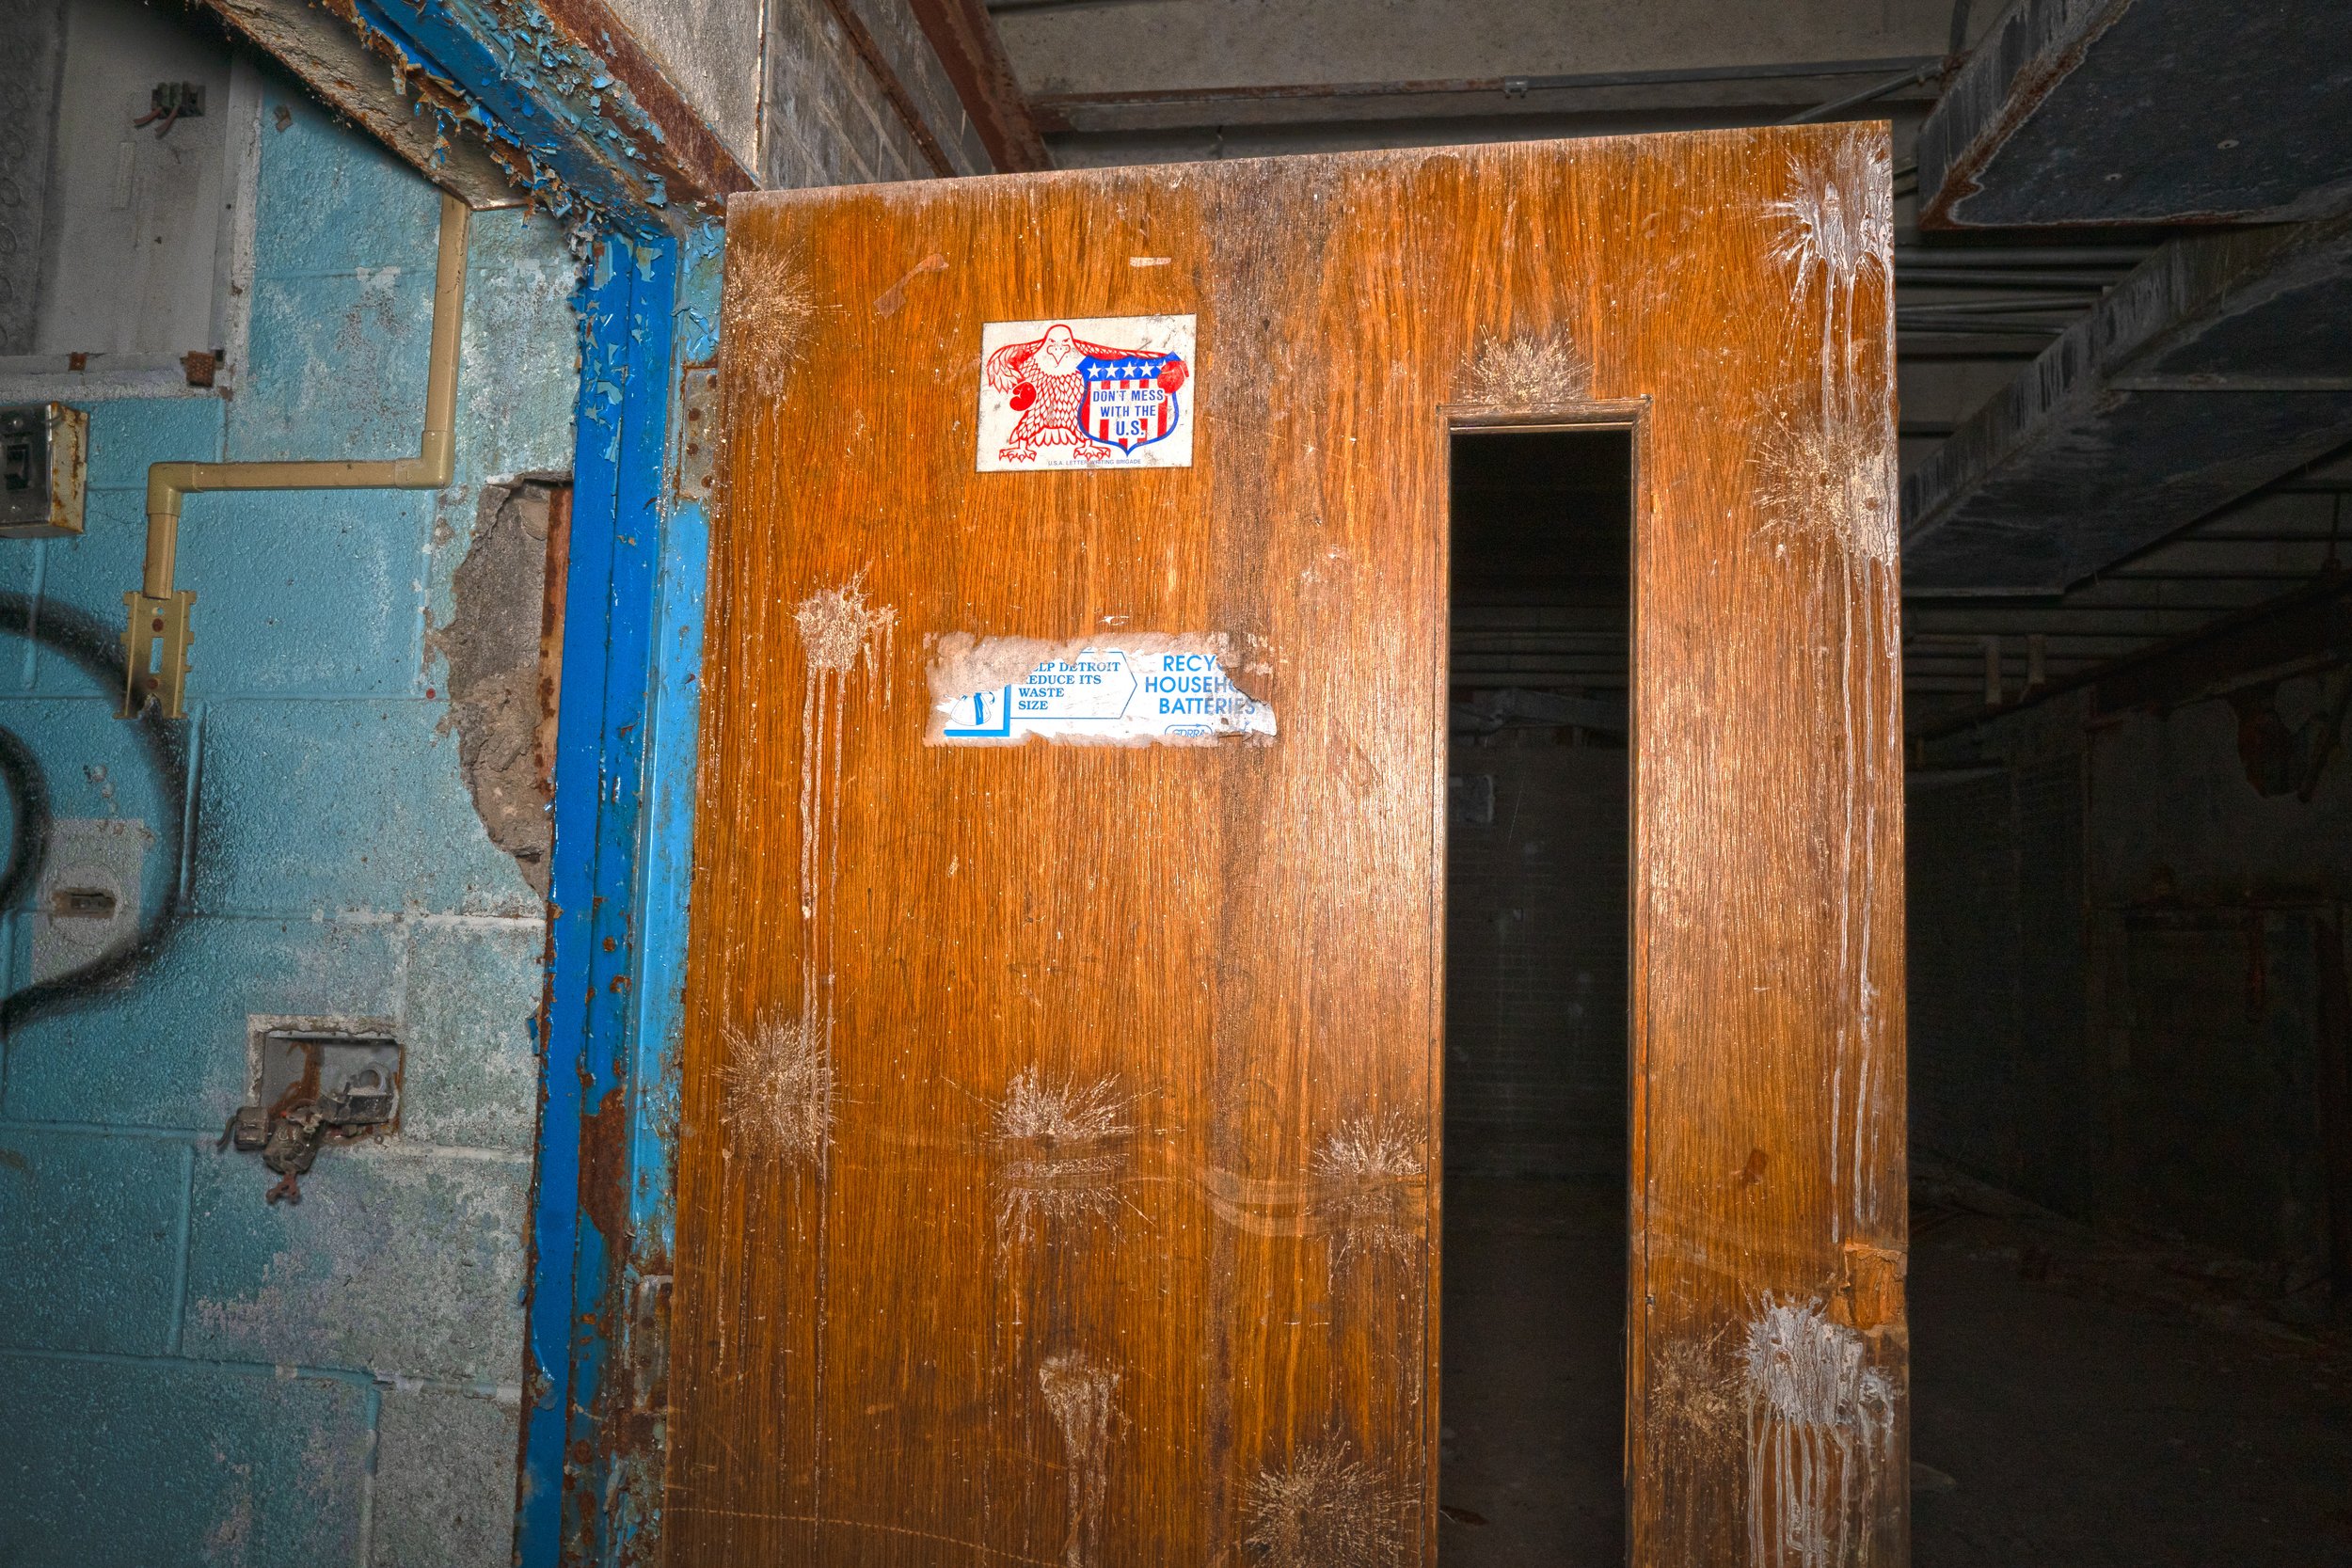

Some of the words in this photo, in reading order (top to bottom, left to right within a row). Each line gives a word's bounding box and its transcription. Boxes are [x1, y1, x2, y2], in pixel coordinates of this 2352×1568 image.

[1093, 390, 1127, 402] DON'T
[1131, 389, 1164, 401] MESS
[1100, 405, 1130, 417] WITH
[1135, 404, 1156, 416] THE
[1116, 420, 1145, 436] U.S.
[1058, 661, 1121, 673] DETROIT
[1163, 654, 1223, 672] RECY
[1025, 674, 1075, 685] EDUCE
[1079, 674, 1102, 685] ITS
[1018, 688, 1065, 698] WASTE
[1018, 700, 1049, 710] SIZE
[1159, 697, 1256, 715] BATTERIES
